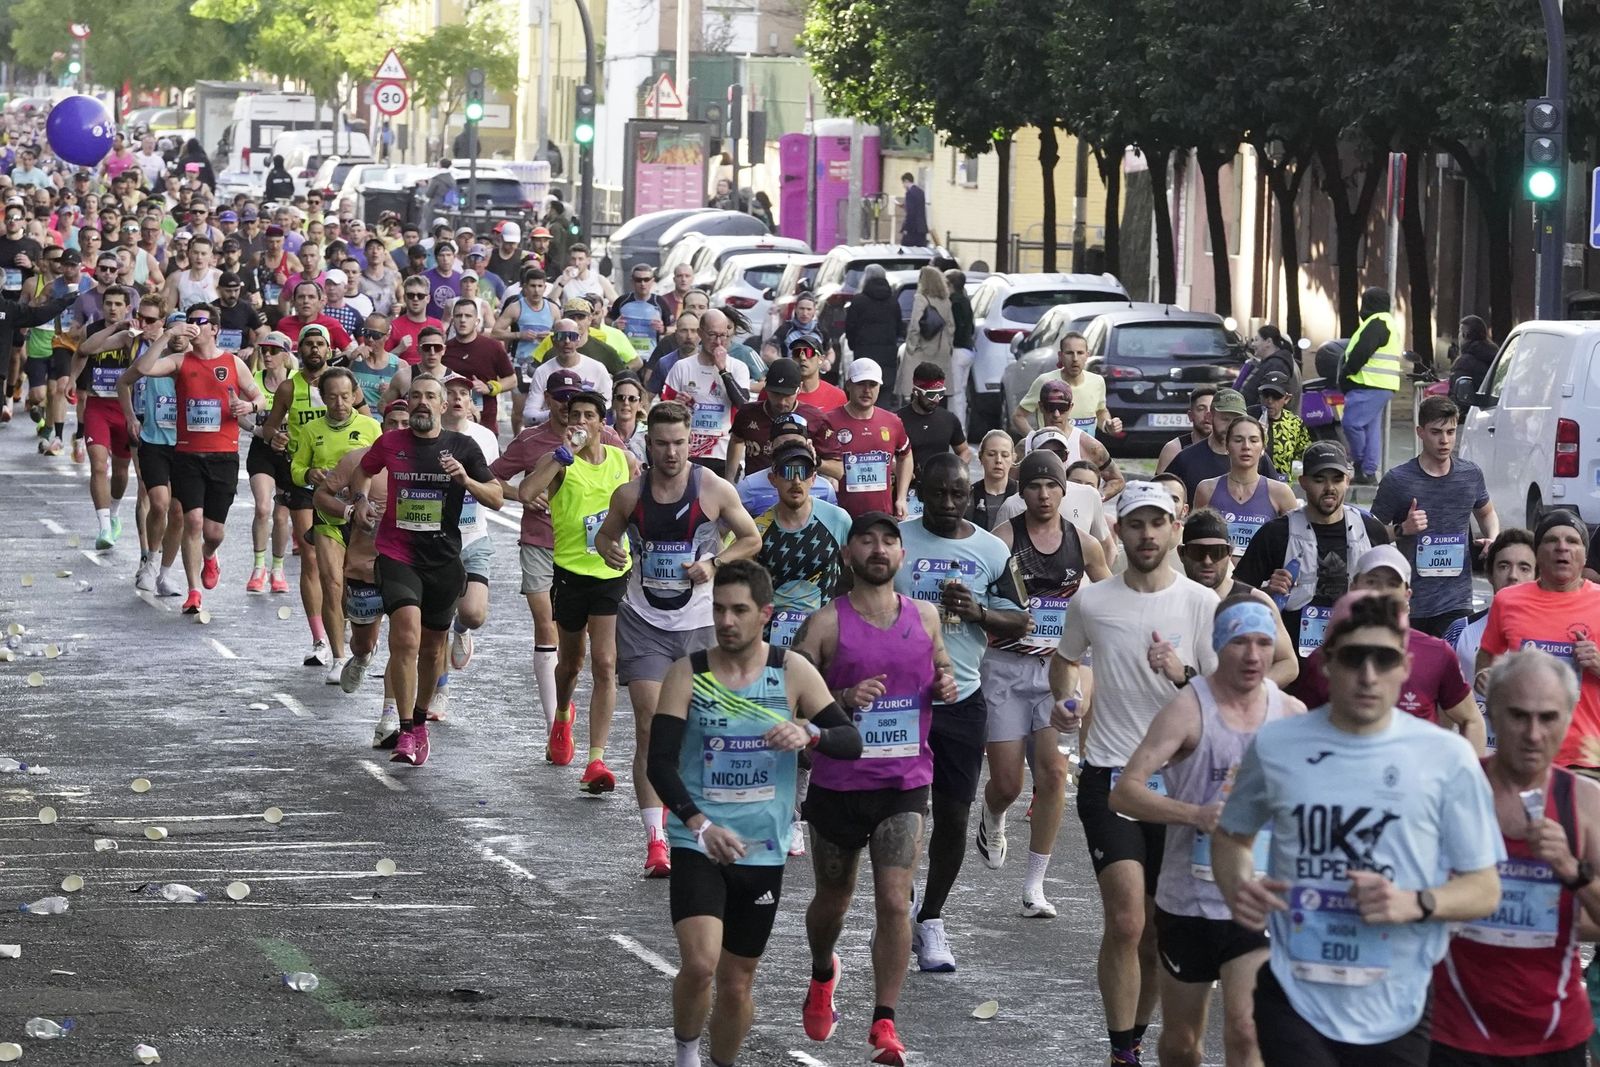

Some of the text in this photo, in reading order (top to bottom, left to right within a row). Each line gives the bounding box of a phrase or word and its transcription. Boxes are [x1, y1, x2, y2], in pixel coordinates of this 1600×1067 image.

[381, 92, 401, 104] 30
[695, 420, 718, 428] DIETER
[1156, 415, 1182, 425] 4249
[857, 475, 877, 483] FRAN
[411, 491, 437, 499] ZURICH
[405, 512, 432, 522] JORGE
[1238, 515, 1265, 523] ZURICH
[1238, 527, 1253, 535] 7209
[1434, 536, 1460, 544] ZURICH
[656, 544, 686, 552] ZURICH
[1428, 557, 1452, 567] JOAN
[654, 567, 677, 578] WILL
[1042, 614, 1058, 623] 6585
[877, 699, 912, 709] ZURICH
[877, 718, 897, 727] 5809
[865, 729, 907, 744] OLIVER
[729, 739, 768, 749] ZURICH
[729, 759, 752, 769] 7573
[711, 769, 768, 787] NICOLÁS
[1292, 803, 1373, 863] 10K
[1321, 941, 1359, 962] EDU
